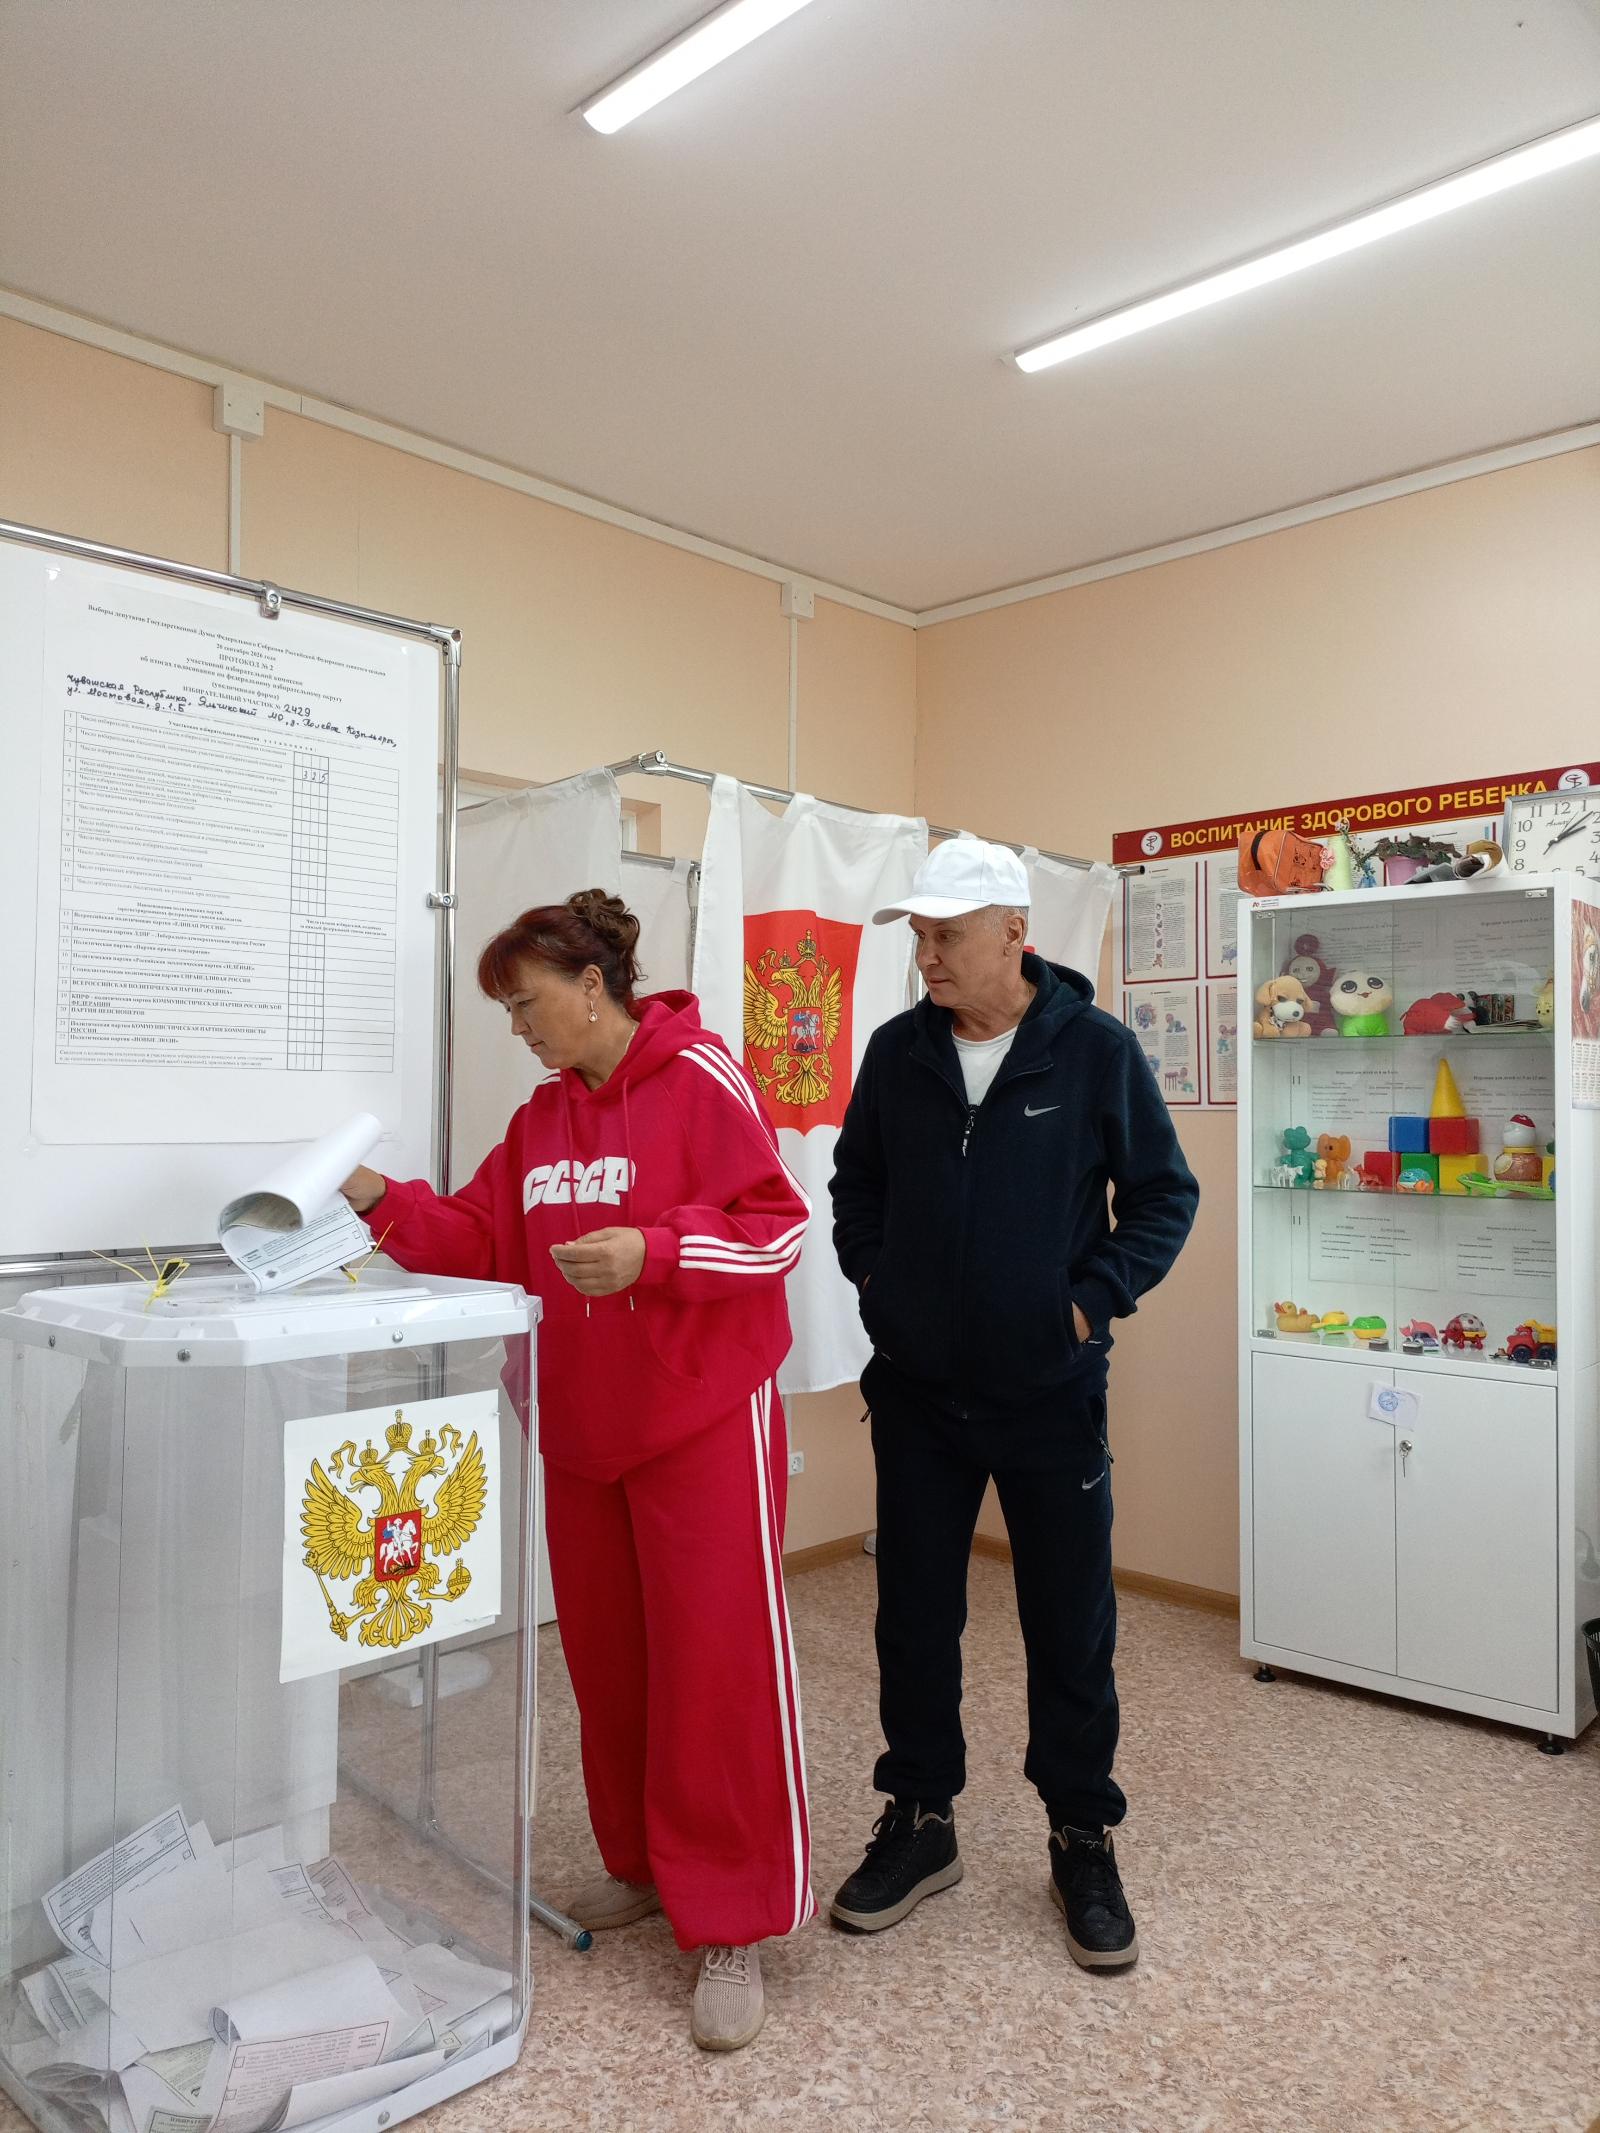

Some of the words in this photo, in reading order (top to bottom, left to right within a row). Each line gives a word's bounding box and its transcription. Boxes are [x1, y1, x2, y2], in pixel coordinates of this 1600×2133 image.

[88, 604, 113, 615] Выборы
[224, 646, 249, 657] сентября
[218, 653, 259, 668] ПРОТОКОЛ
[261, 662, 268, 670] №
[186, 657, 224, 671] участковой
[224, 665, 272, 680] избирательной
[273, 673, 303, 686] комиссии
[149, 657, 171, 667] итогах
[173, 663, 214, 676] голосования
[226, 672, 270, 688] федеральному
[272, 683, 320, 699] избирательному
[322, 694, 342, 703] округу
[182, 685, 240, 702] ИЗБИРАТЕЛЬНЫЙ
[242, 696, 274, 710] УЧАСТОК
[284, 704, 311, 718] 2429
[256, 690, 280, 701] форма)
[1531, 805, 1543, 818] 11
[1554, 802, 1571, 815] 12
[1582, 800, 1587, 811] 1
[1170, 815, 1295, 848] ВОСПИТАНИЕ
[1301, 796, 1432, 831] ЗДОРОВОГО
[1439, 780, 1548, 811] РЕБЕНКА
[1518, 820, 1532, 832] 10
[1591, 831, 1600, 843] 3
[1515, 839, 1526, 852] 9
[1589, 851, 1600, 863] 4
[1514, 858, 1525, 871] 8
[71, 993, 89, 1001] КПРФ
[523, 1156, 636, 1215] СССР
